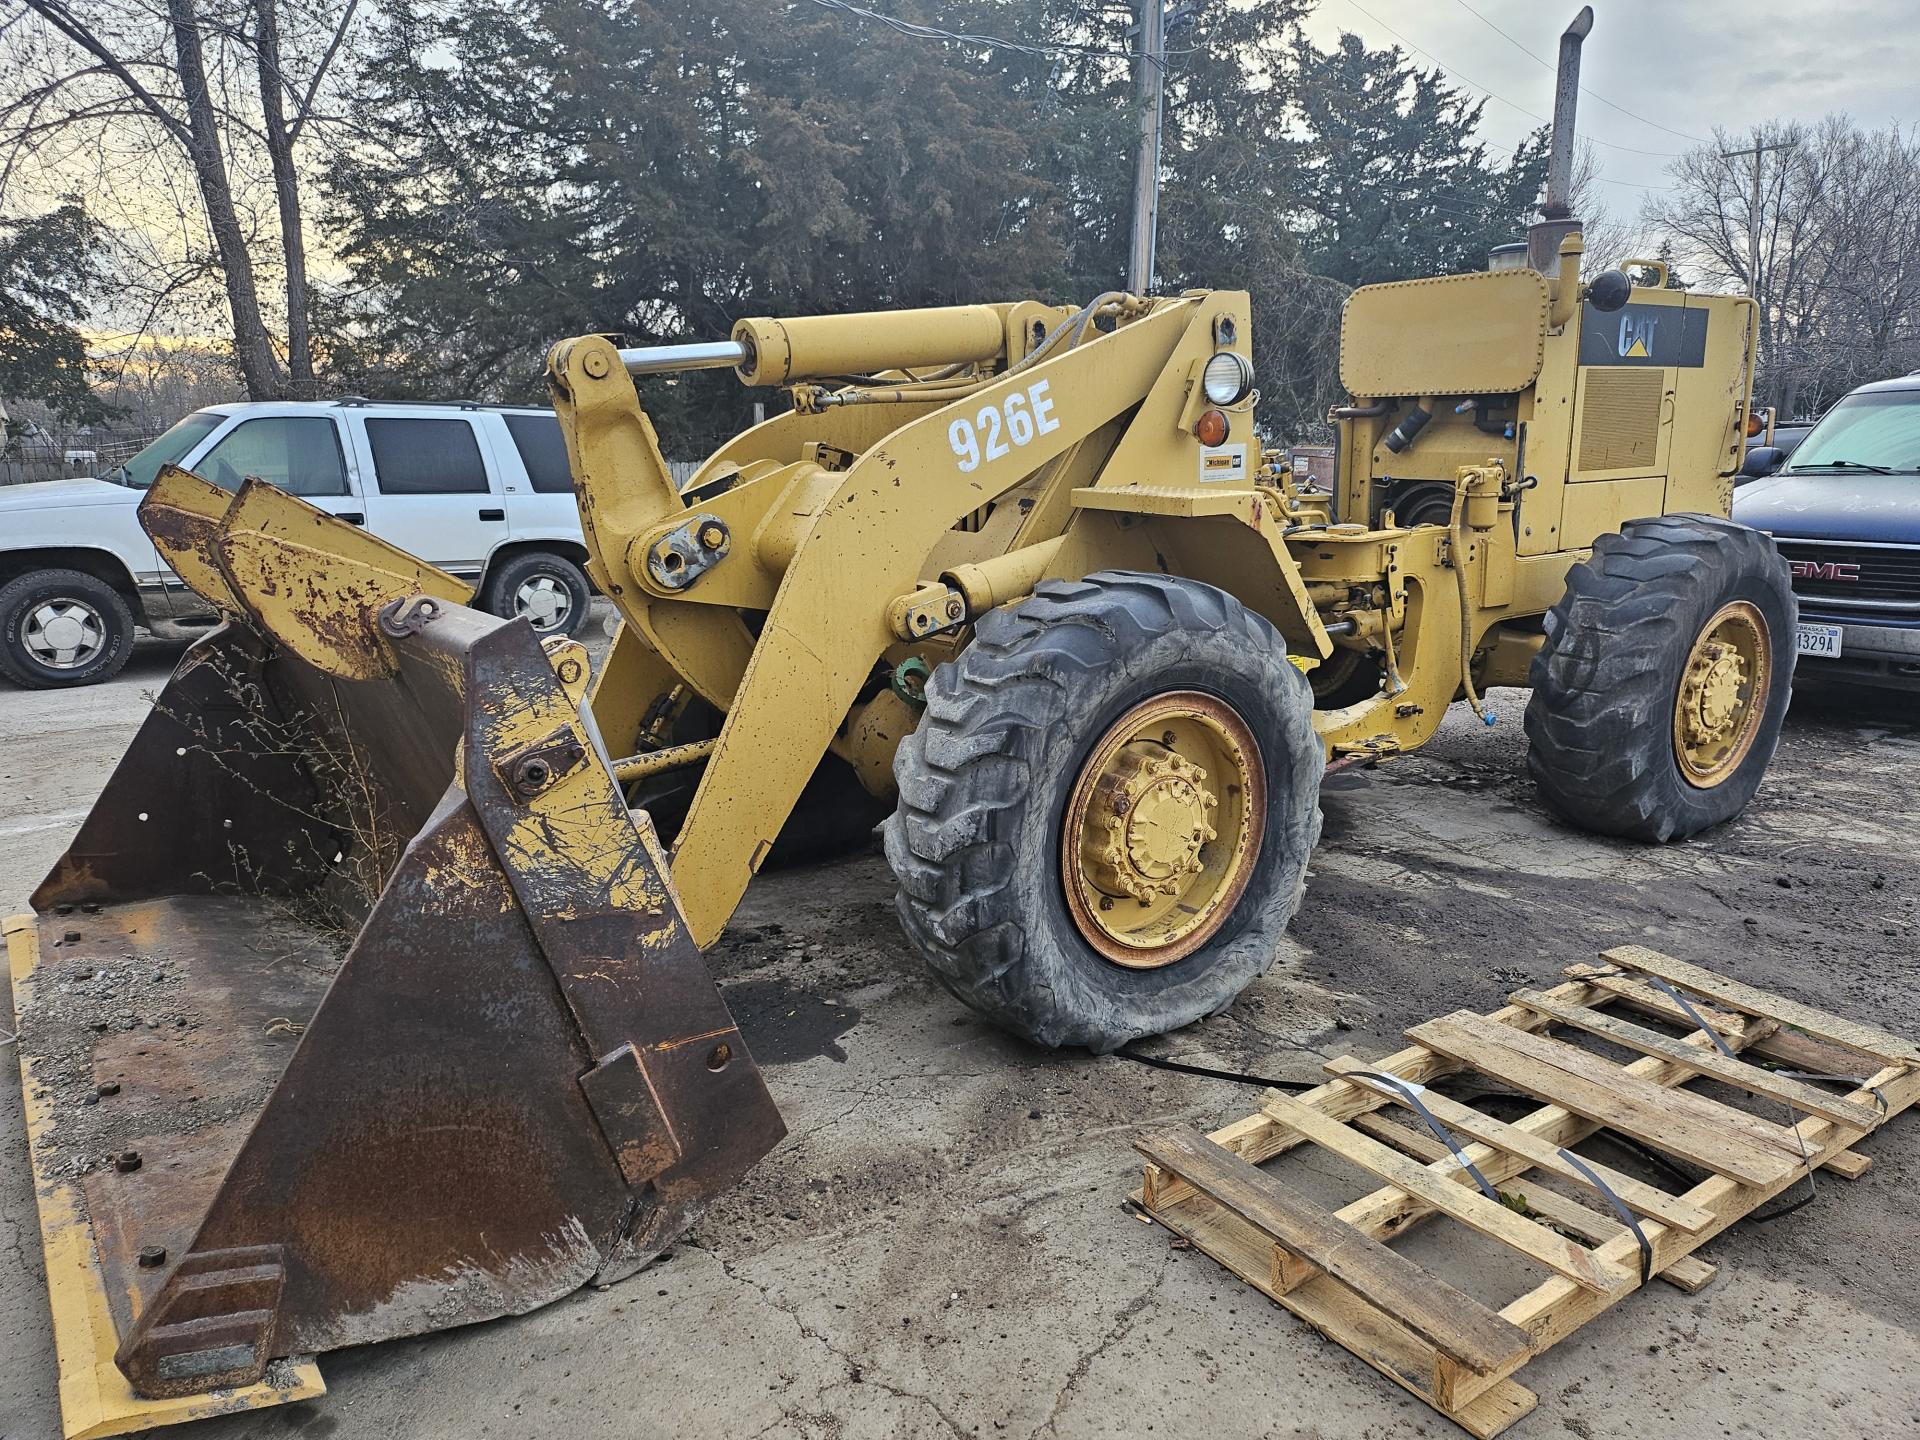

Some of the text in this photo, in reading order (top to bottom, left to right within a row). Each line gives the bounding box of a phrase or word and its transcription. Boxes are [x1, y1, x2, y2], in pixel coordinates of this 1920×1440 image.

[1618, 314, 1659, 357] CAT
[948, 378, 1061, 473] 926E
[1787, 560, 1861, 581] GMC
